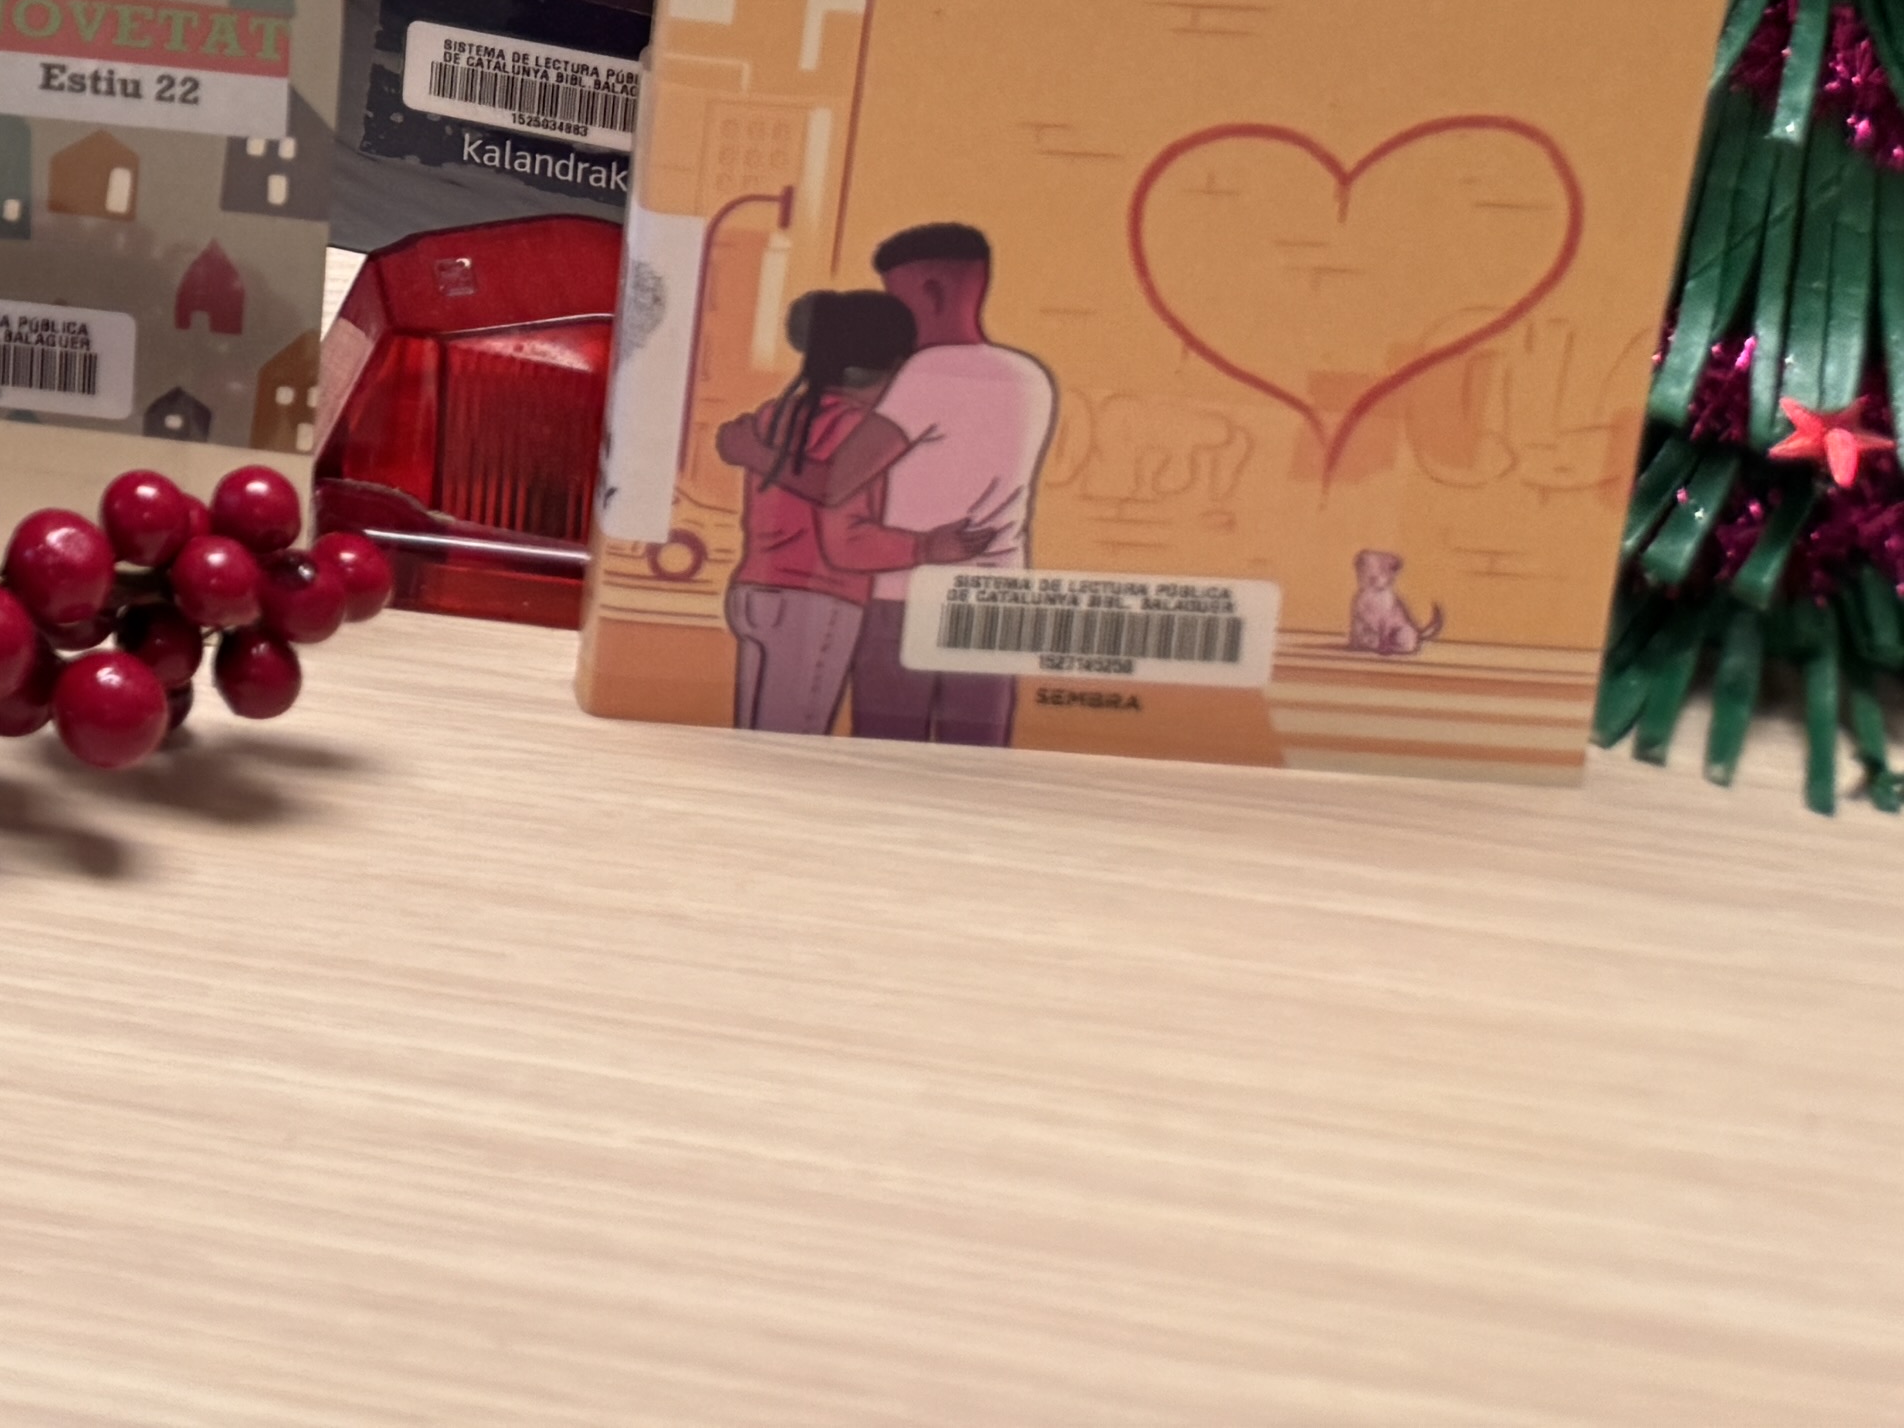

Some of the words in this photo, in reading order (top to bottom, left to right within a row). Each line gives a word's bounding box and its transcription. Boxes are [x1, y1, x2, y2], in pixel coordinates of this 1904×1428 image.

[443, 51, 461, 65] DE
[466, 55, 550, 81] CATALUNYA
[444, 39, 506, 61] SISTEMA
[511, 51, 530, 65] DE
[535, 56, 600, 78] LECTURA
[39, 62, 145, 103] Estiu
[153, 73, 201, 106] 22
[18, 315, 89, 336] PÚBLICA
[1039, 578, 1061, 593] DE
[1035, 687, 1142, 711] SEMBRA
